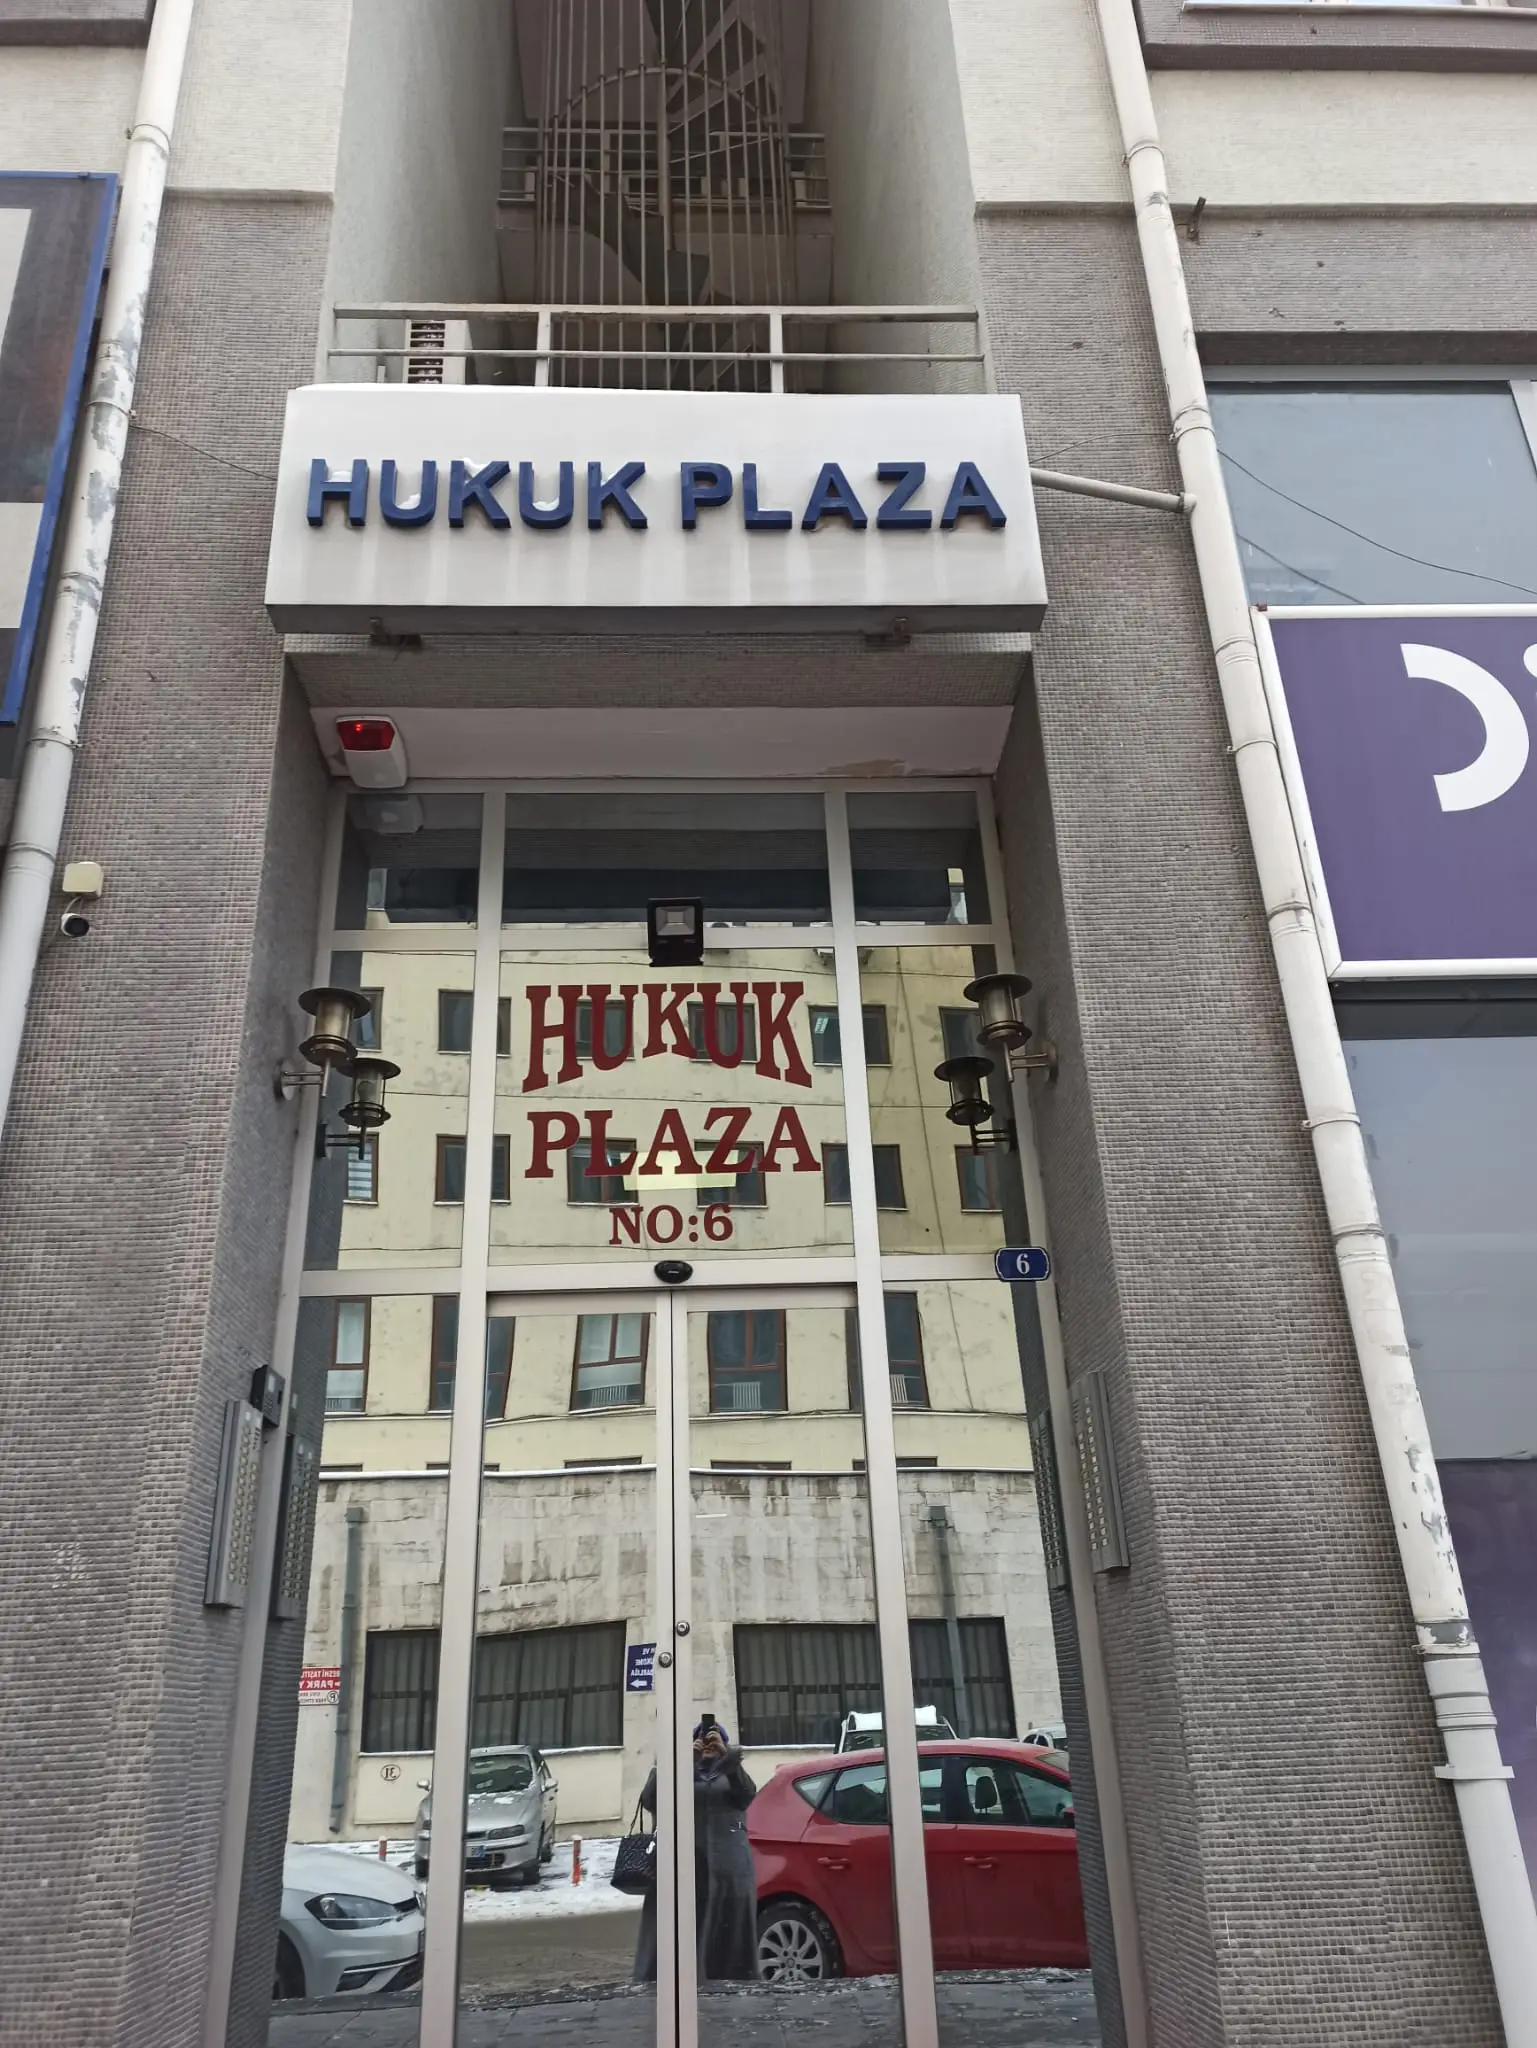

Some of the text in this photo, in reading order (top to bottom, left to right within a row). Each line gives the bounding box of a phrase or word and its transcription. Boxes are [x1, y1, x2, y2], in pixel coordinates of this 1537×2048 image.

[307, 458, 1007, 531] HUKUK PLAZA
[522, 981, 812, 1093] HUKUK
[524, 1106, 821, 1178] PLAZA
[609, 1203, 733, 1245] NO:6
[1016, 1253, 1030, 1275] 6
